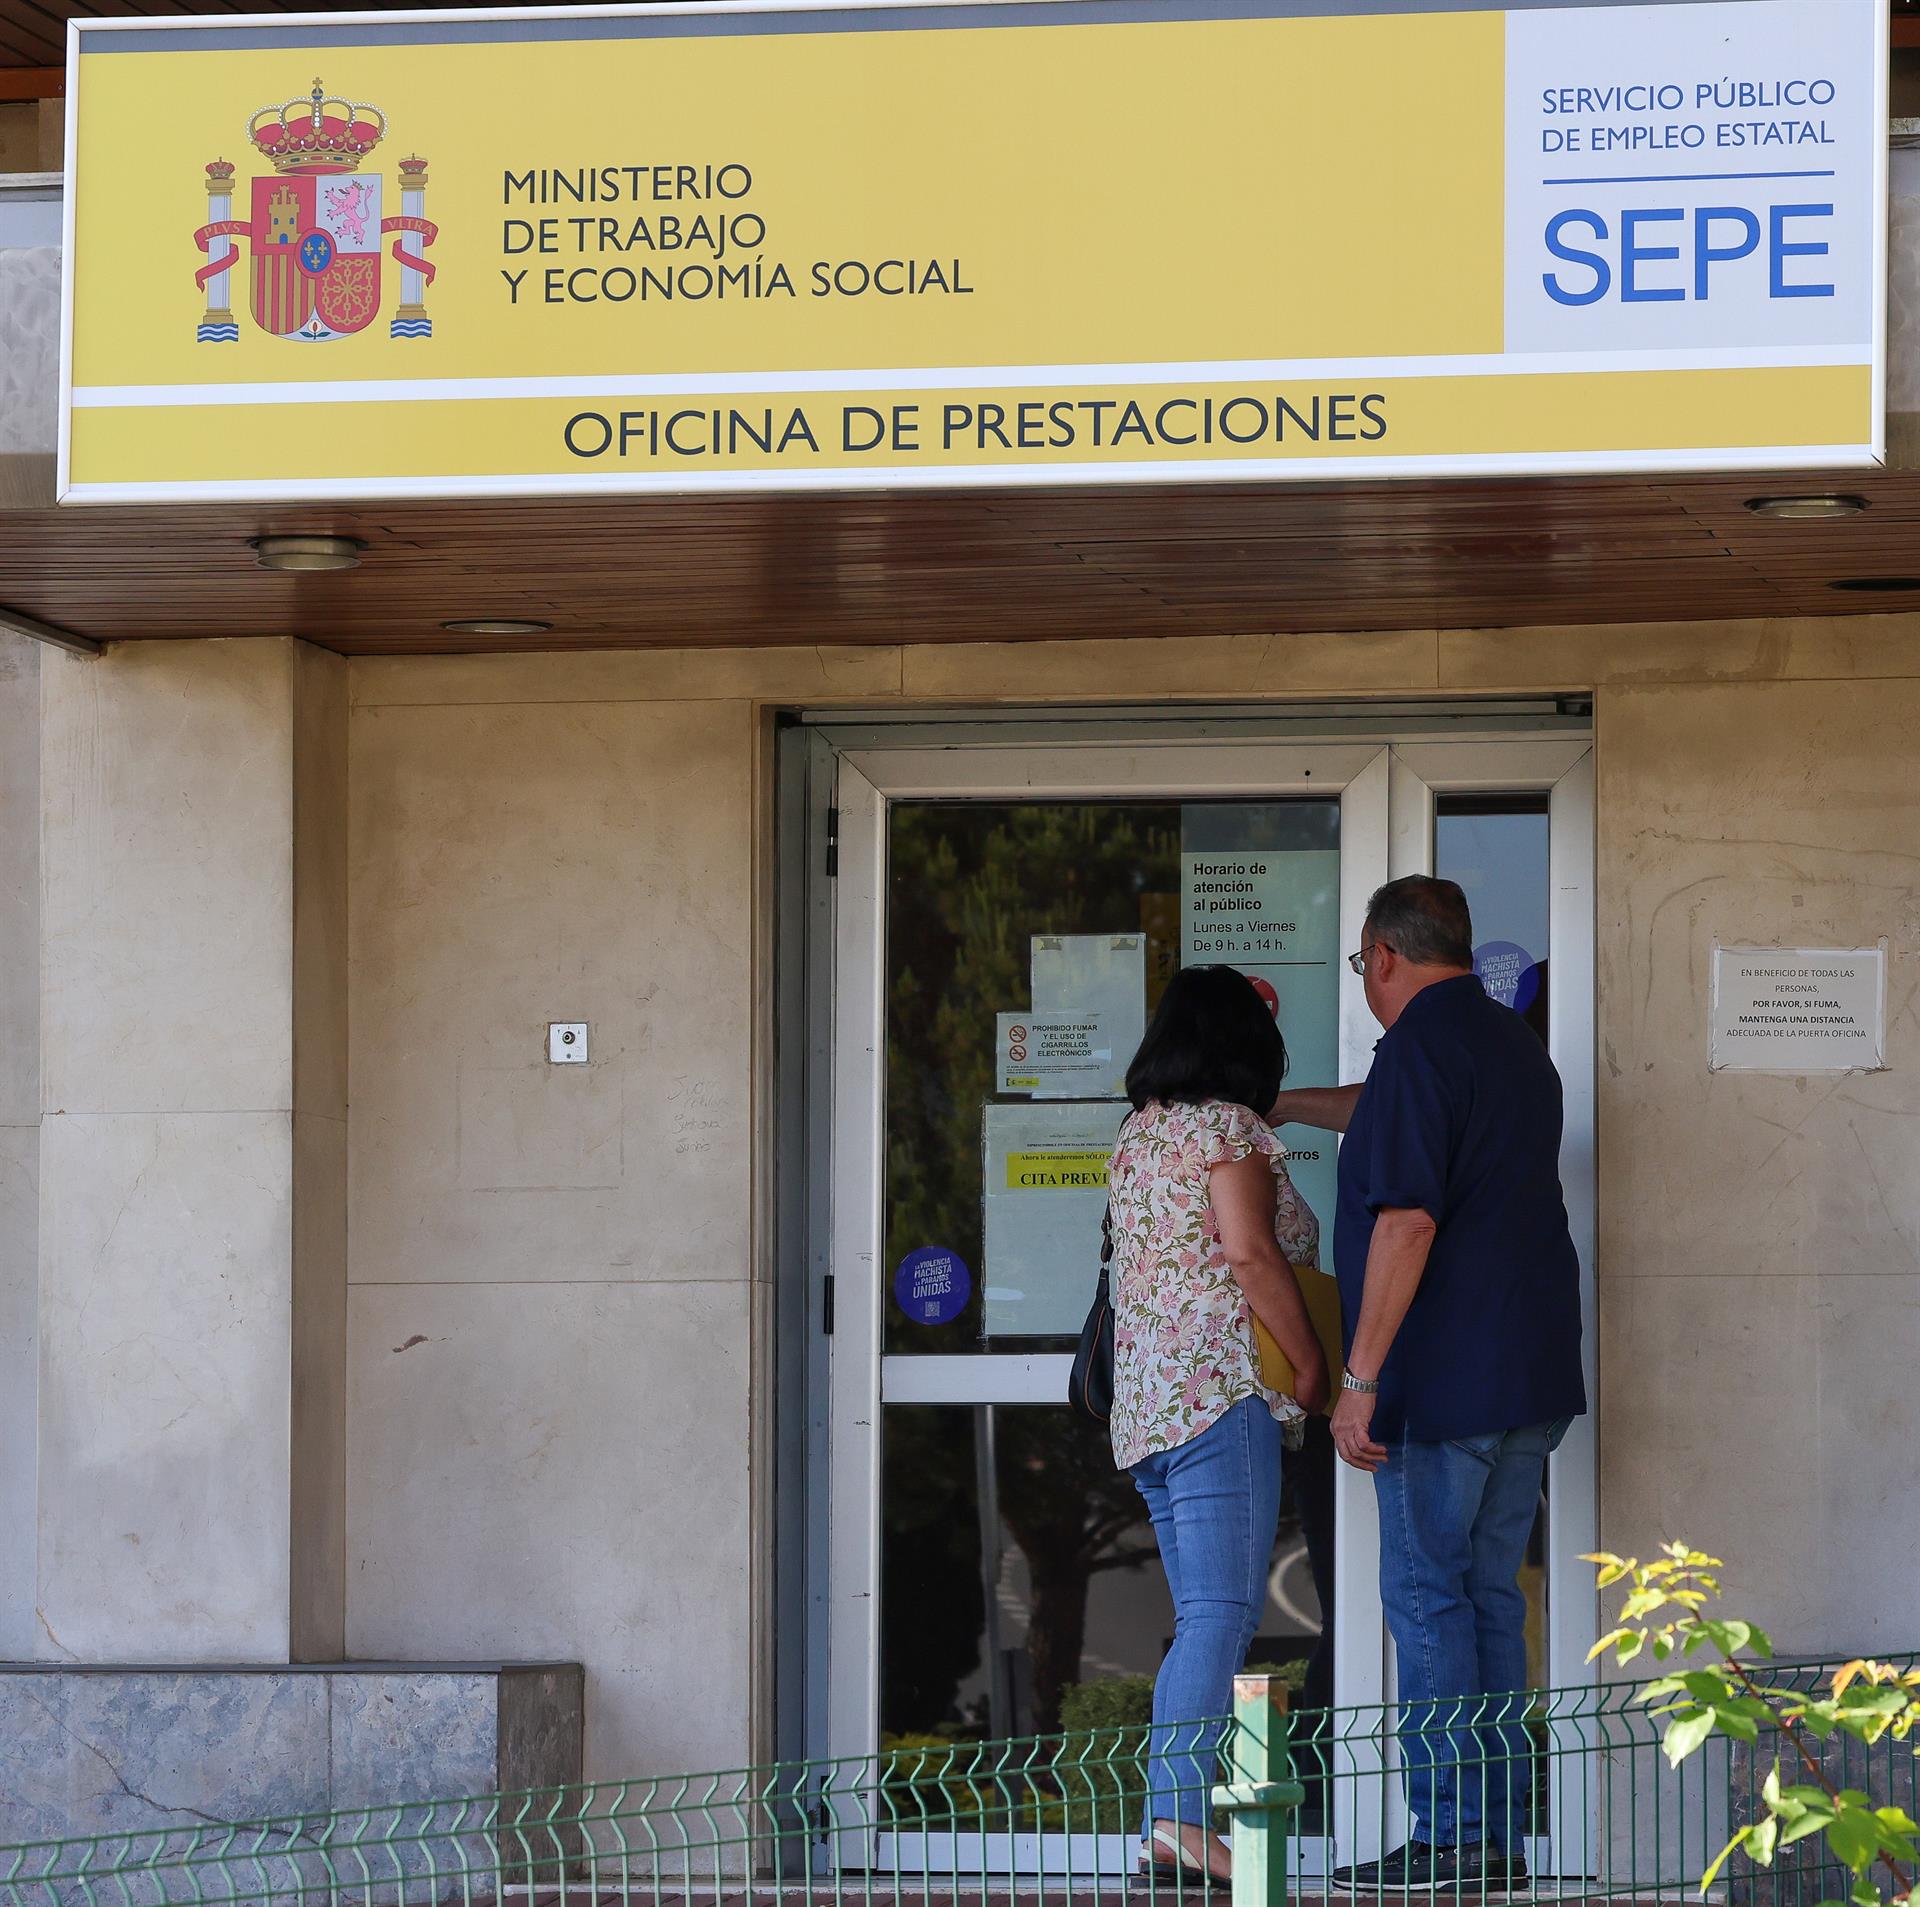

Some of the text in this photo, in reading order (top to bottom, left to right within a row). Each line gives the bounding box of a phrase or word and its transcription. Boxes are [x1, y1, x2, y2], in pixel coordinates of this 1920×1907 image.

[1542, 76, 1835, 114] SERVICIO PÚBLICO
[1542, 120, 1835, 153] DE EMPLEO ESTATAL
[504, 164, 752, 204] MINISTERIO
[504, 213, 766, 260] DE TRABAJO
[1542, 203, 1835, 306] SEPE
[500, 254, 974, 304] Y ECONOMÍA SOCIAL
[564, 394, 1387, 458] OFICINA DE PRESTACIONES
[1194, 862, 1267, 875] Horario de
[1193, 880, 1253, 893] atención
[1193, 898, 1262, 913] al público
[1193, 921, 1296, 933] Lunes a Viernes
[1193, 939, 1286, 951] De 9 h. a 14 h.
[1487, 952, 1519, 963] VIOLENCIA
[1481, 960, 1520, 974] MACHISTA
[1754, 969, 1796, 977] BENEFICIO
[1798, 969, 1809, 977] DE
[1810, 970, 1838, 978] TODAS
[1840, 970, 1855, 978] LAS
[1775, 985, 1820, 994] PERSONAS,
[1753, 1000, 1841, 1009] POR FAVOR, SI FUMA,
[1739, 1015, 1788, 1023] MANTENGA
[1810, 1016, 1855, 1024] DISTANCIA
[1726, 1029, 1771, 1037] ADECUADA
[1798, 1030, 1830, 1038] PUERTA
[1831, 1030, 1867, 1038] OFICINA
[1038, 1049, 1092, 1057] ELECTRÓNICOS
[1085, 1152, 1105, 1160] SÓLO
[1020, 1172, 1110, 1185] CITA PREVI
[920, 1257, 951, 1268] VIOLENCIA
[914, 1264, 952, 1279] MACHISTA
[921, 1274, 949, 1285] PARAMOS
[913, 1281, 952, 1299] UNIDAS
